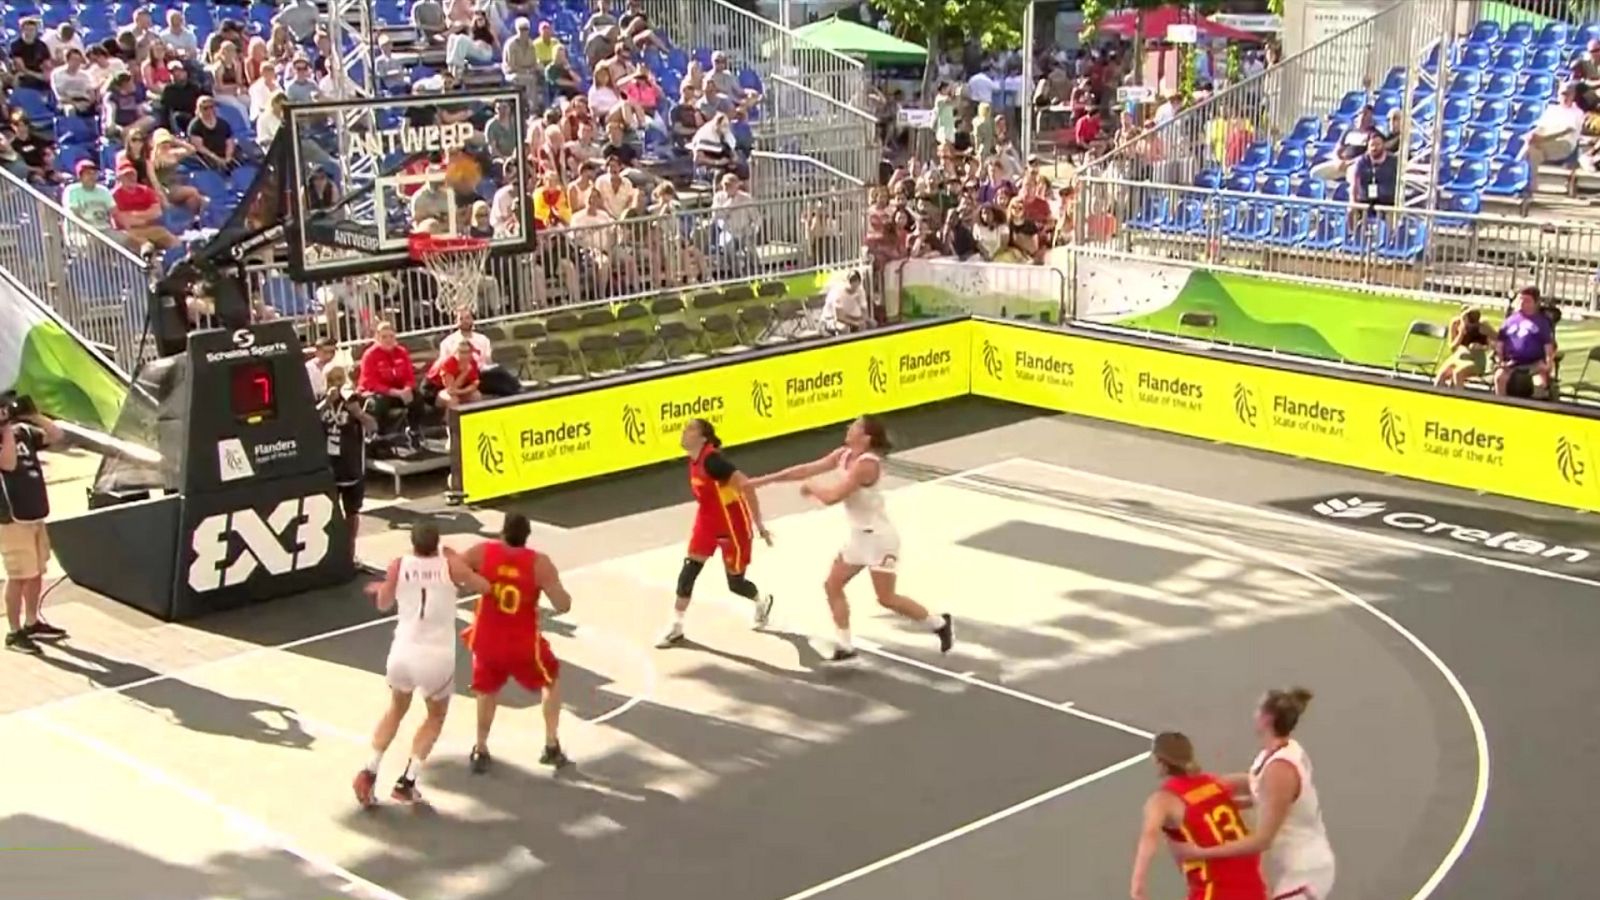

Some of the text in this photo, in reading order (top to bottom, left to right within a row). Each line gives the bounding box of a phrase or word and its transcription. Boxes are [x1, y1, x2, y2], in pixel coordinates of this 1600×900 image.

[348, 122, 474, 158] ANTWERP
[334, 229, 379, 250] ANTWERP
[899, 348, 951, 372] Flanders
[1015, 350, 1075, 376] Flanders
[254, 377, 269, 404] 7
[786, 371, 843, 395] Flanders
[1138, 371, 1203, 399] Flanders
[661, 395, 724, 421] Flanders
[1273, 395, 1345, 423] Flanders
[254, 439, 297, 456] Flanders
[520, 421, 591, 449] Flanders
[1424, 421, 1504, 451] Flanders
[521, 440, 591, 464] State of the Art
[1424, 442, 1503, 467] State of the Art
[1382, 511, 1590, 563] Crelan
[420, 587, 426, 620] 1
[1203, 805, 1245, 846] 13
